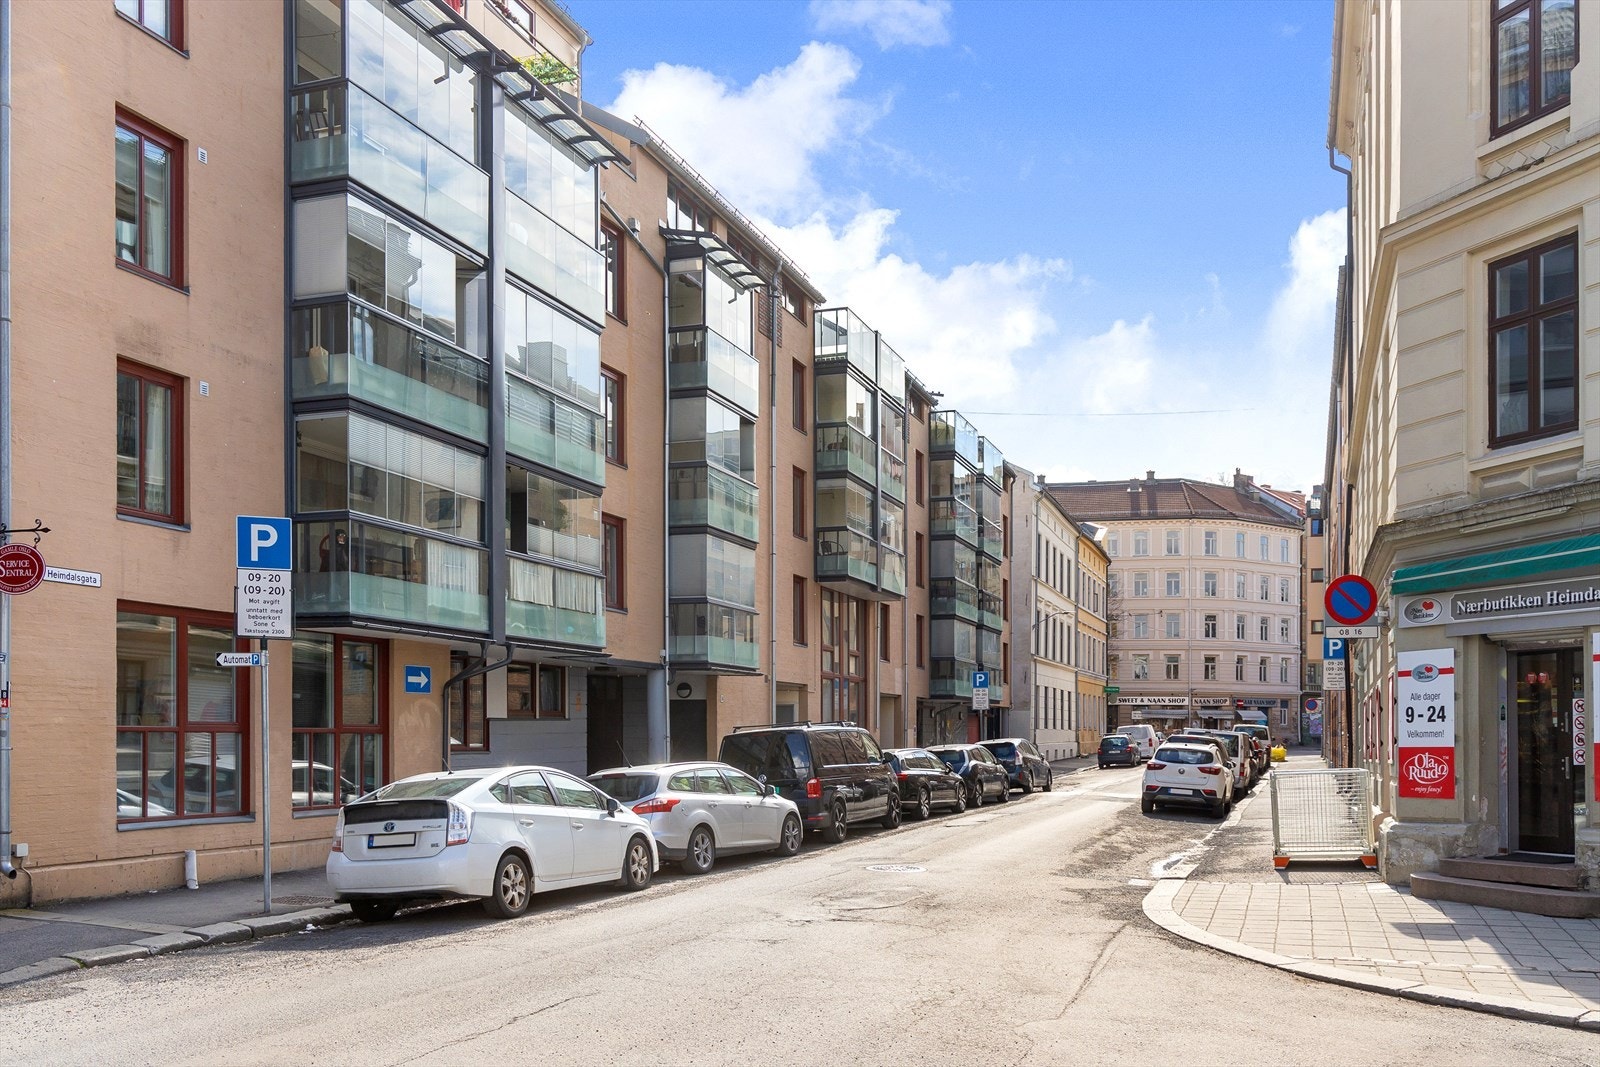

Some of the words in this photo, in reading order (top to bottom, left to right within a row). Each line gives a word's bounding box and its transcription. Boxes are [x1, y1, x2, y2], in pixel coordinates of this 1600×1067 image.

[250, 524, 278, 562] P
[47, 569, 97, 584] Heimdalsgata
[1456, 594, 1542, 614] Nærbutikken
[1329, 639, 1342, 657] P
[223, 655, 251, 664] Automat
[976, 674, 985, 686] P
[1423, 692, 1440, 702] dager
[1407, 730, 1445, 738] Velkommen!
[1414, 752, 1435, 769] Ola
